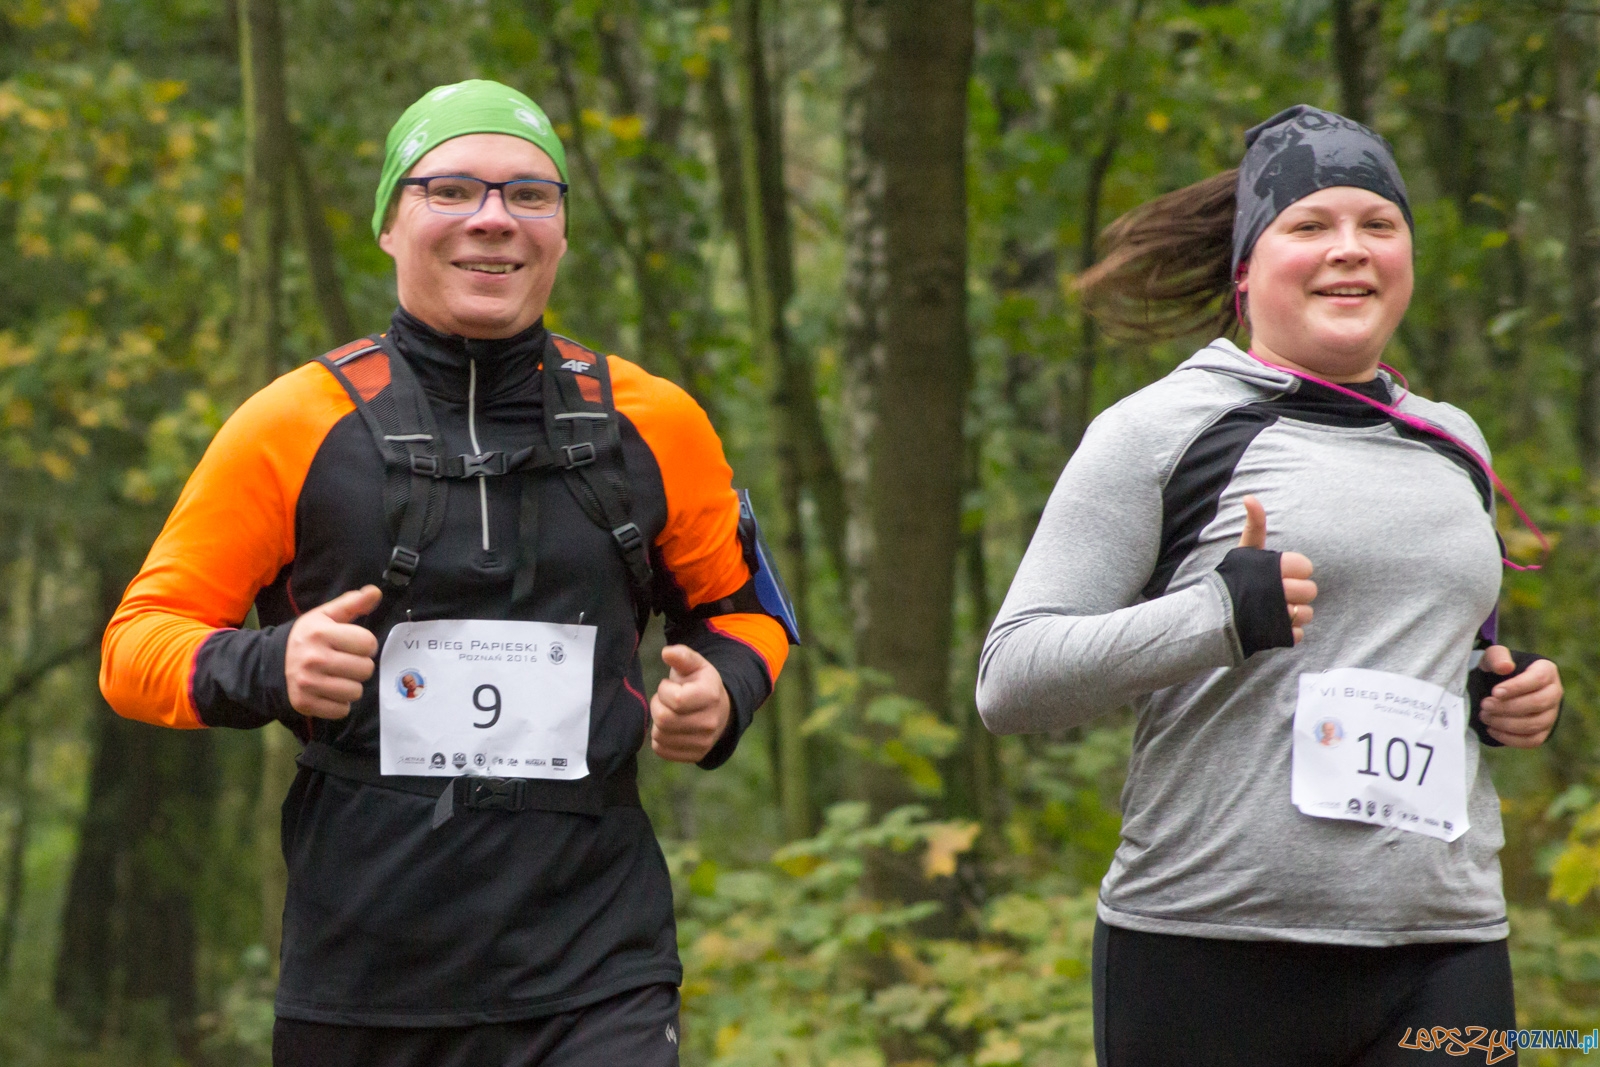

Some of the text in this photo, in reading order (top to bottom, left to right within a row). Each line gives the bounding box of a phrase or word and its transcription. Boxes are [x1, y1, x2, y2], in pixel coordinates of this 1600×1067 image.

[560, 359, 591, 373] 4F
[403, 639, 538, 653] VI BIEG PAPIESKI
[506, 654, 538, 663] 2016
[472, 683, 502, 729] 9
[1356, 732, 1434, 786] 107
